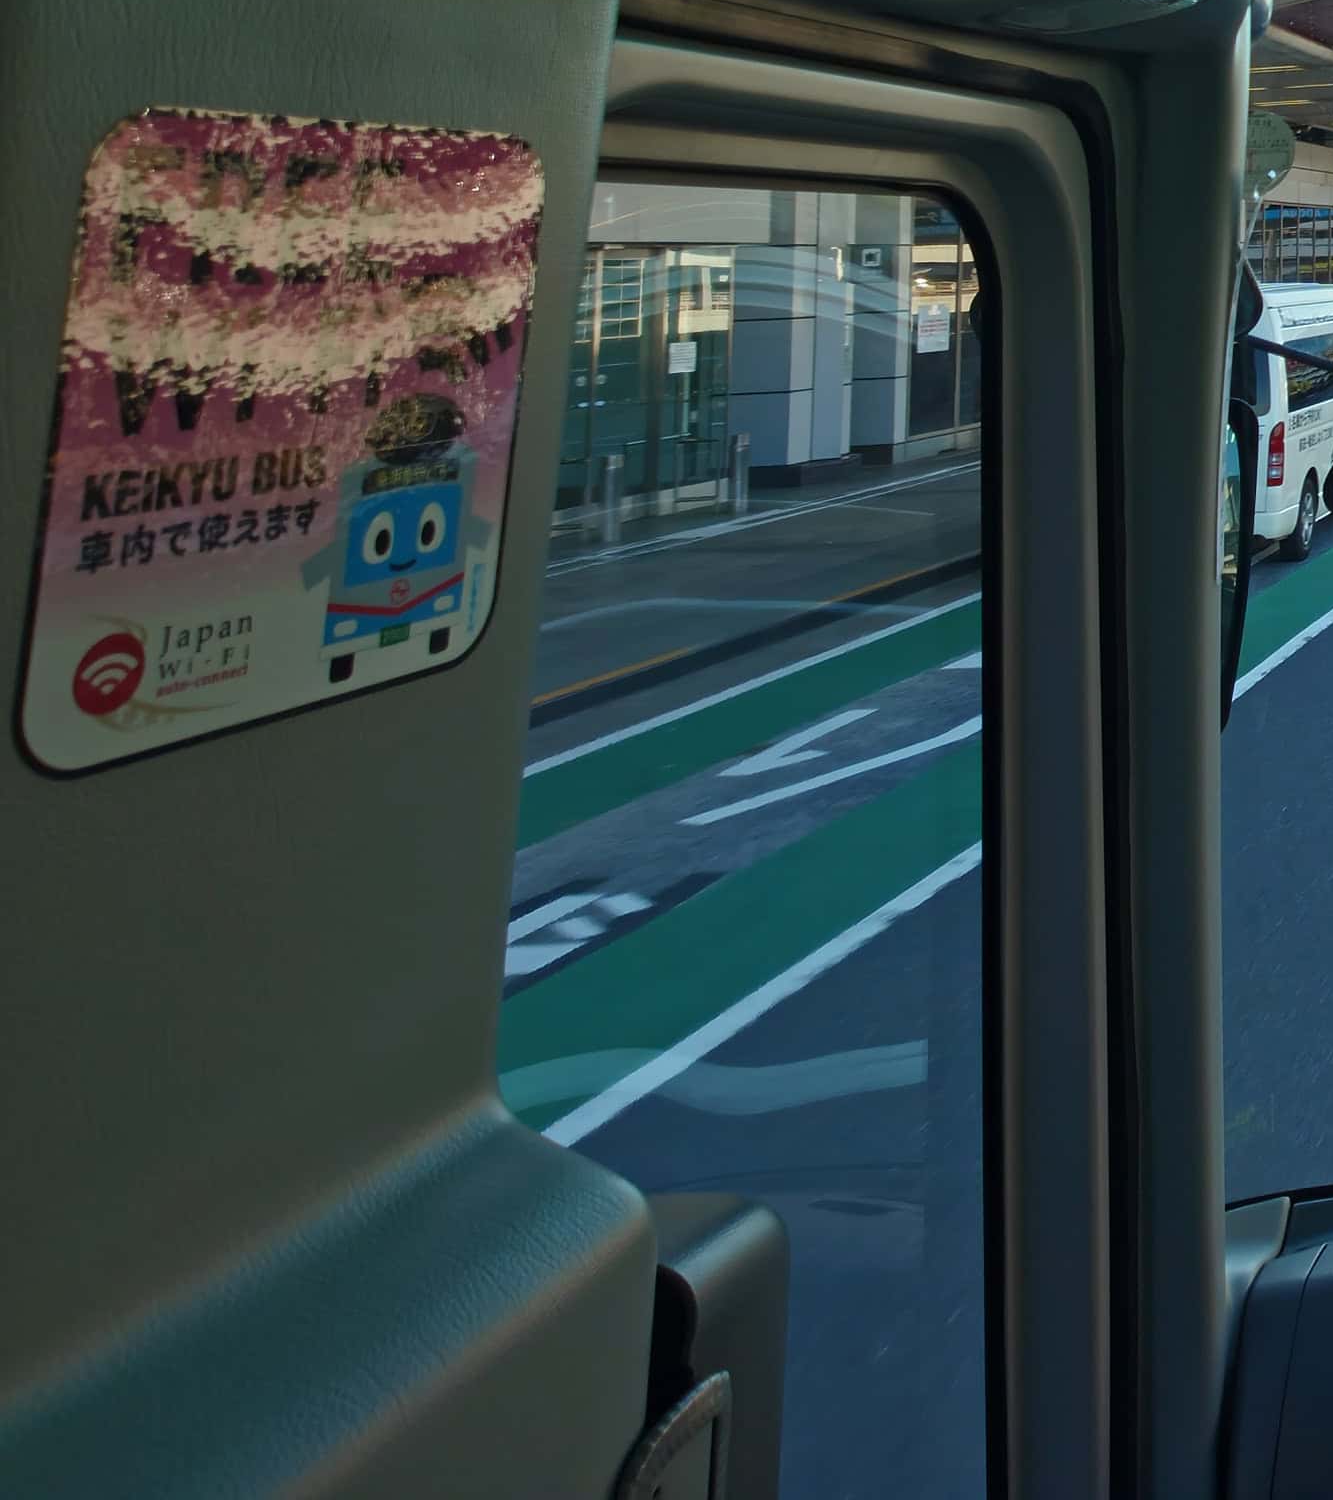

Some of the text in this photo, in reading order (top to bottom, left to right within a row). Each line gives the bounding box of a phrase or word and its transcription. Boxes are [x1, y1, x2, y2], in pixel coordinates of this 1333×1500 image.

[79, 455, 239, 521] KEIKYU
[250, 446, 327, 497] BUS
[75, 499, 321, 575] 車内で使えます
[156, 644, 252, 681] Wi-Fi
[159, 612, 253, 657] Japan
